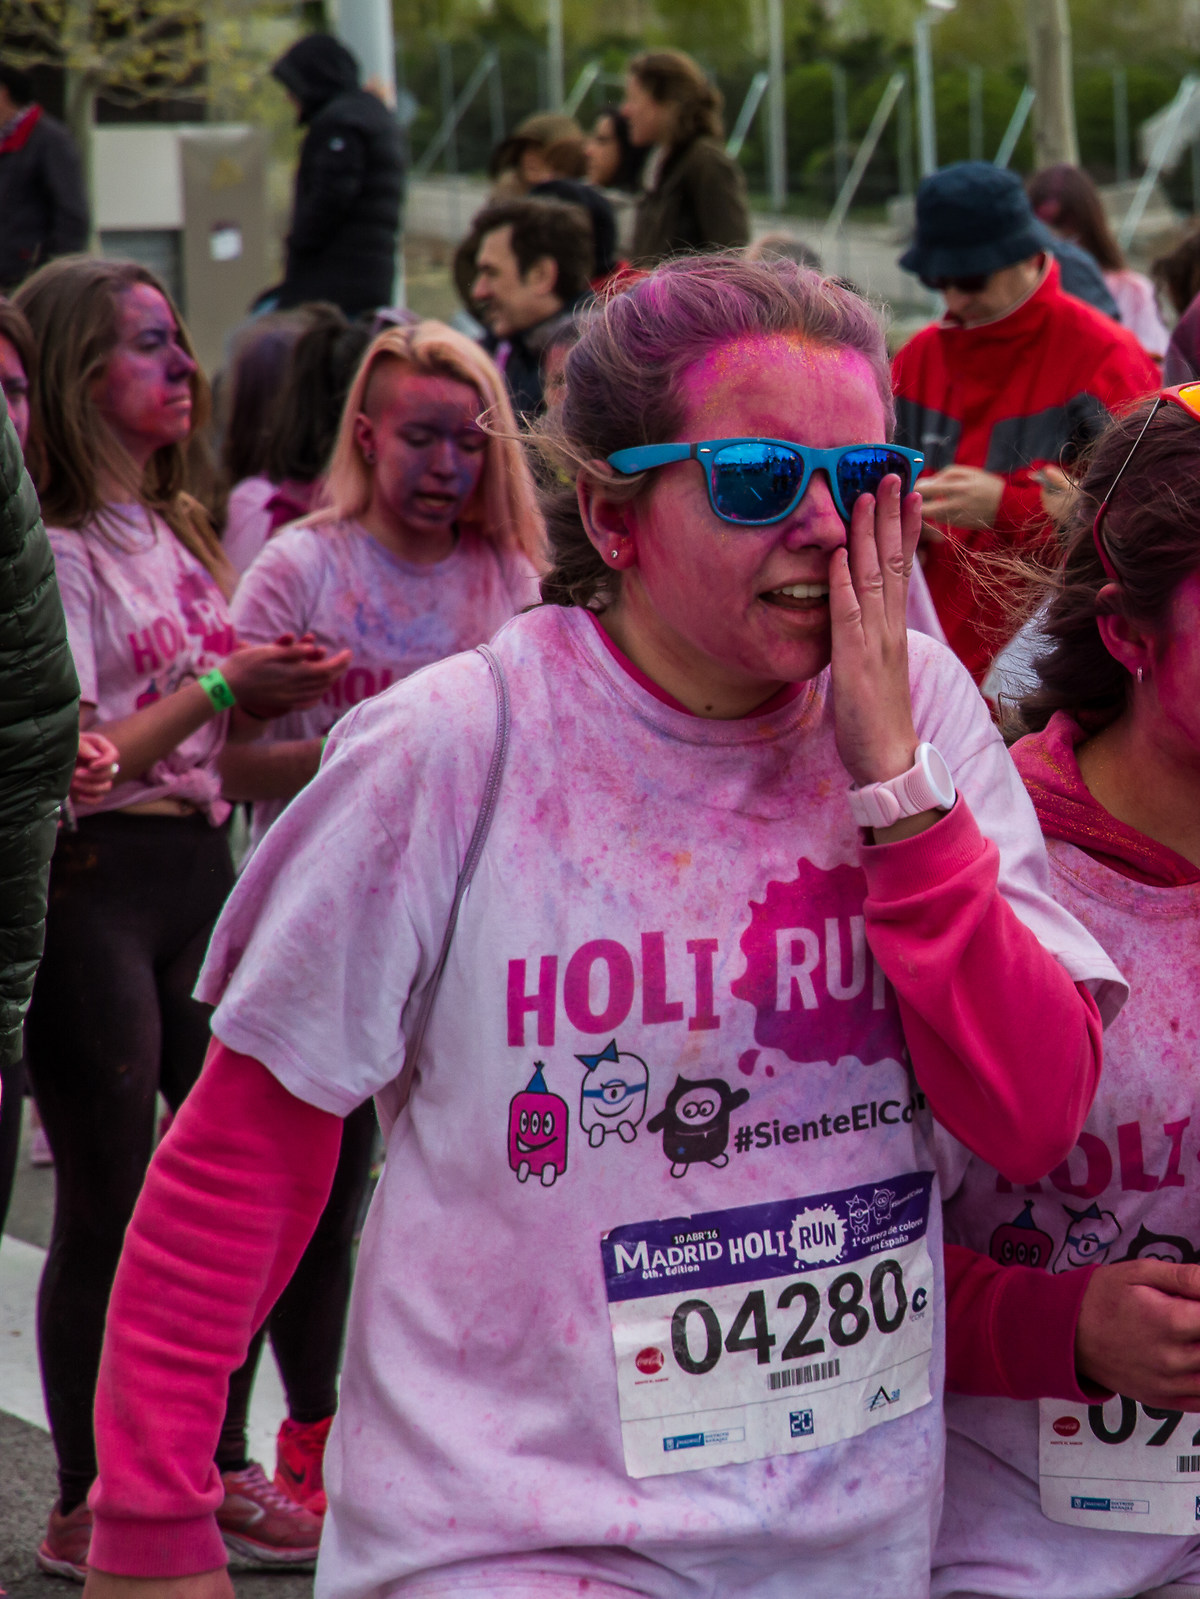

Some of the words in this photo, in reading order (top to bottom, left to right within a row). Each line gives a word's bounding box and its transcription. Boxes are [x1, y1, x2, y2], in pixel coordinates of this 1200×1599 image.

[507, 931, 721, 1047] HOLI
[996, 1116, 1190, 1199] OLI
[674, 1234, 685, 1245] 10
[686, 1229, 718, 1243] ABR'16
[861, 1229, 888, 1245] carrera
[888, 1225, 898, 1237] de
[898, 1216, 924, 1232] colores
[870, 1243, 880, 1252] en
[880, 1233, 909, 1249] España
[613, 1240, 723, 1274] MADRID
[728, 1229, 788, 1265] HOLI
[800, 1221, 838, 1250] RUN
[641, 1267, 663, 1280] 6th.
[665, 1264, 700, 1277] Edition
[671, 1258, 908, 1376] 04280
[791, 1409, 813, 1432] 20
